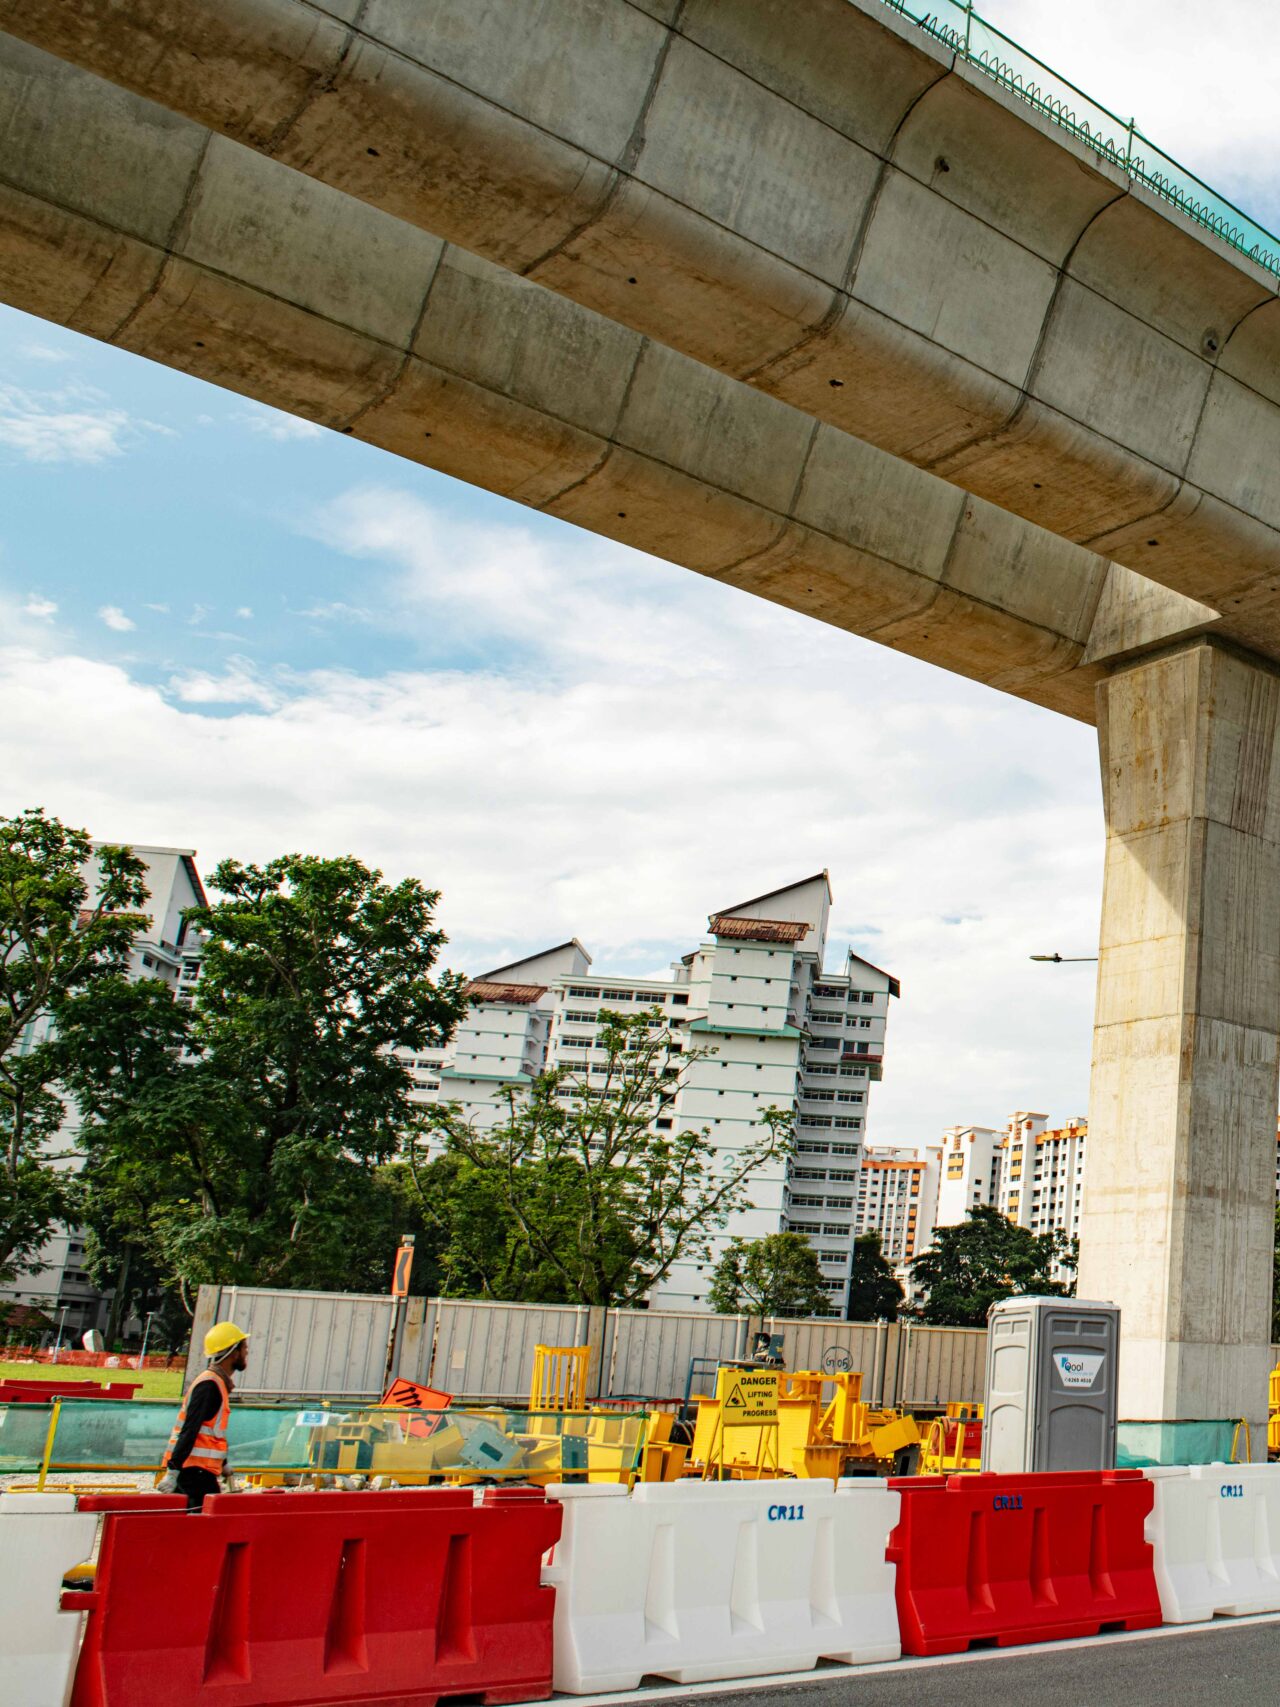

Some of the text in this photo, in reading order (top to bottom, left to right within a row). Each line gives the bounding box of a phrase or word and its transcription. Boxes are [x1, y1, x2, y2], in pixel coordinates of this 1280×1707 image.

[1065, 1361, 1084, 1373] Qool
[740, 1377, 777, 1386] DANGER
[747, 1391, 773, 1399] LIFTING
[1220, 1484, 1244, 1498] CR11
[993, 1494, 1024, 1511] CR11
[767, 1504, 805, 1521] CR11
